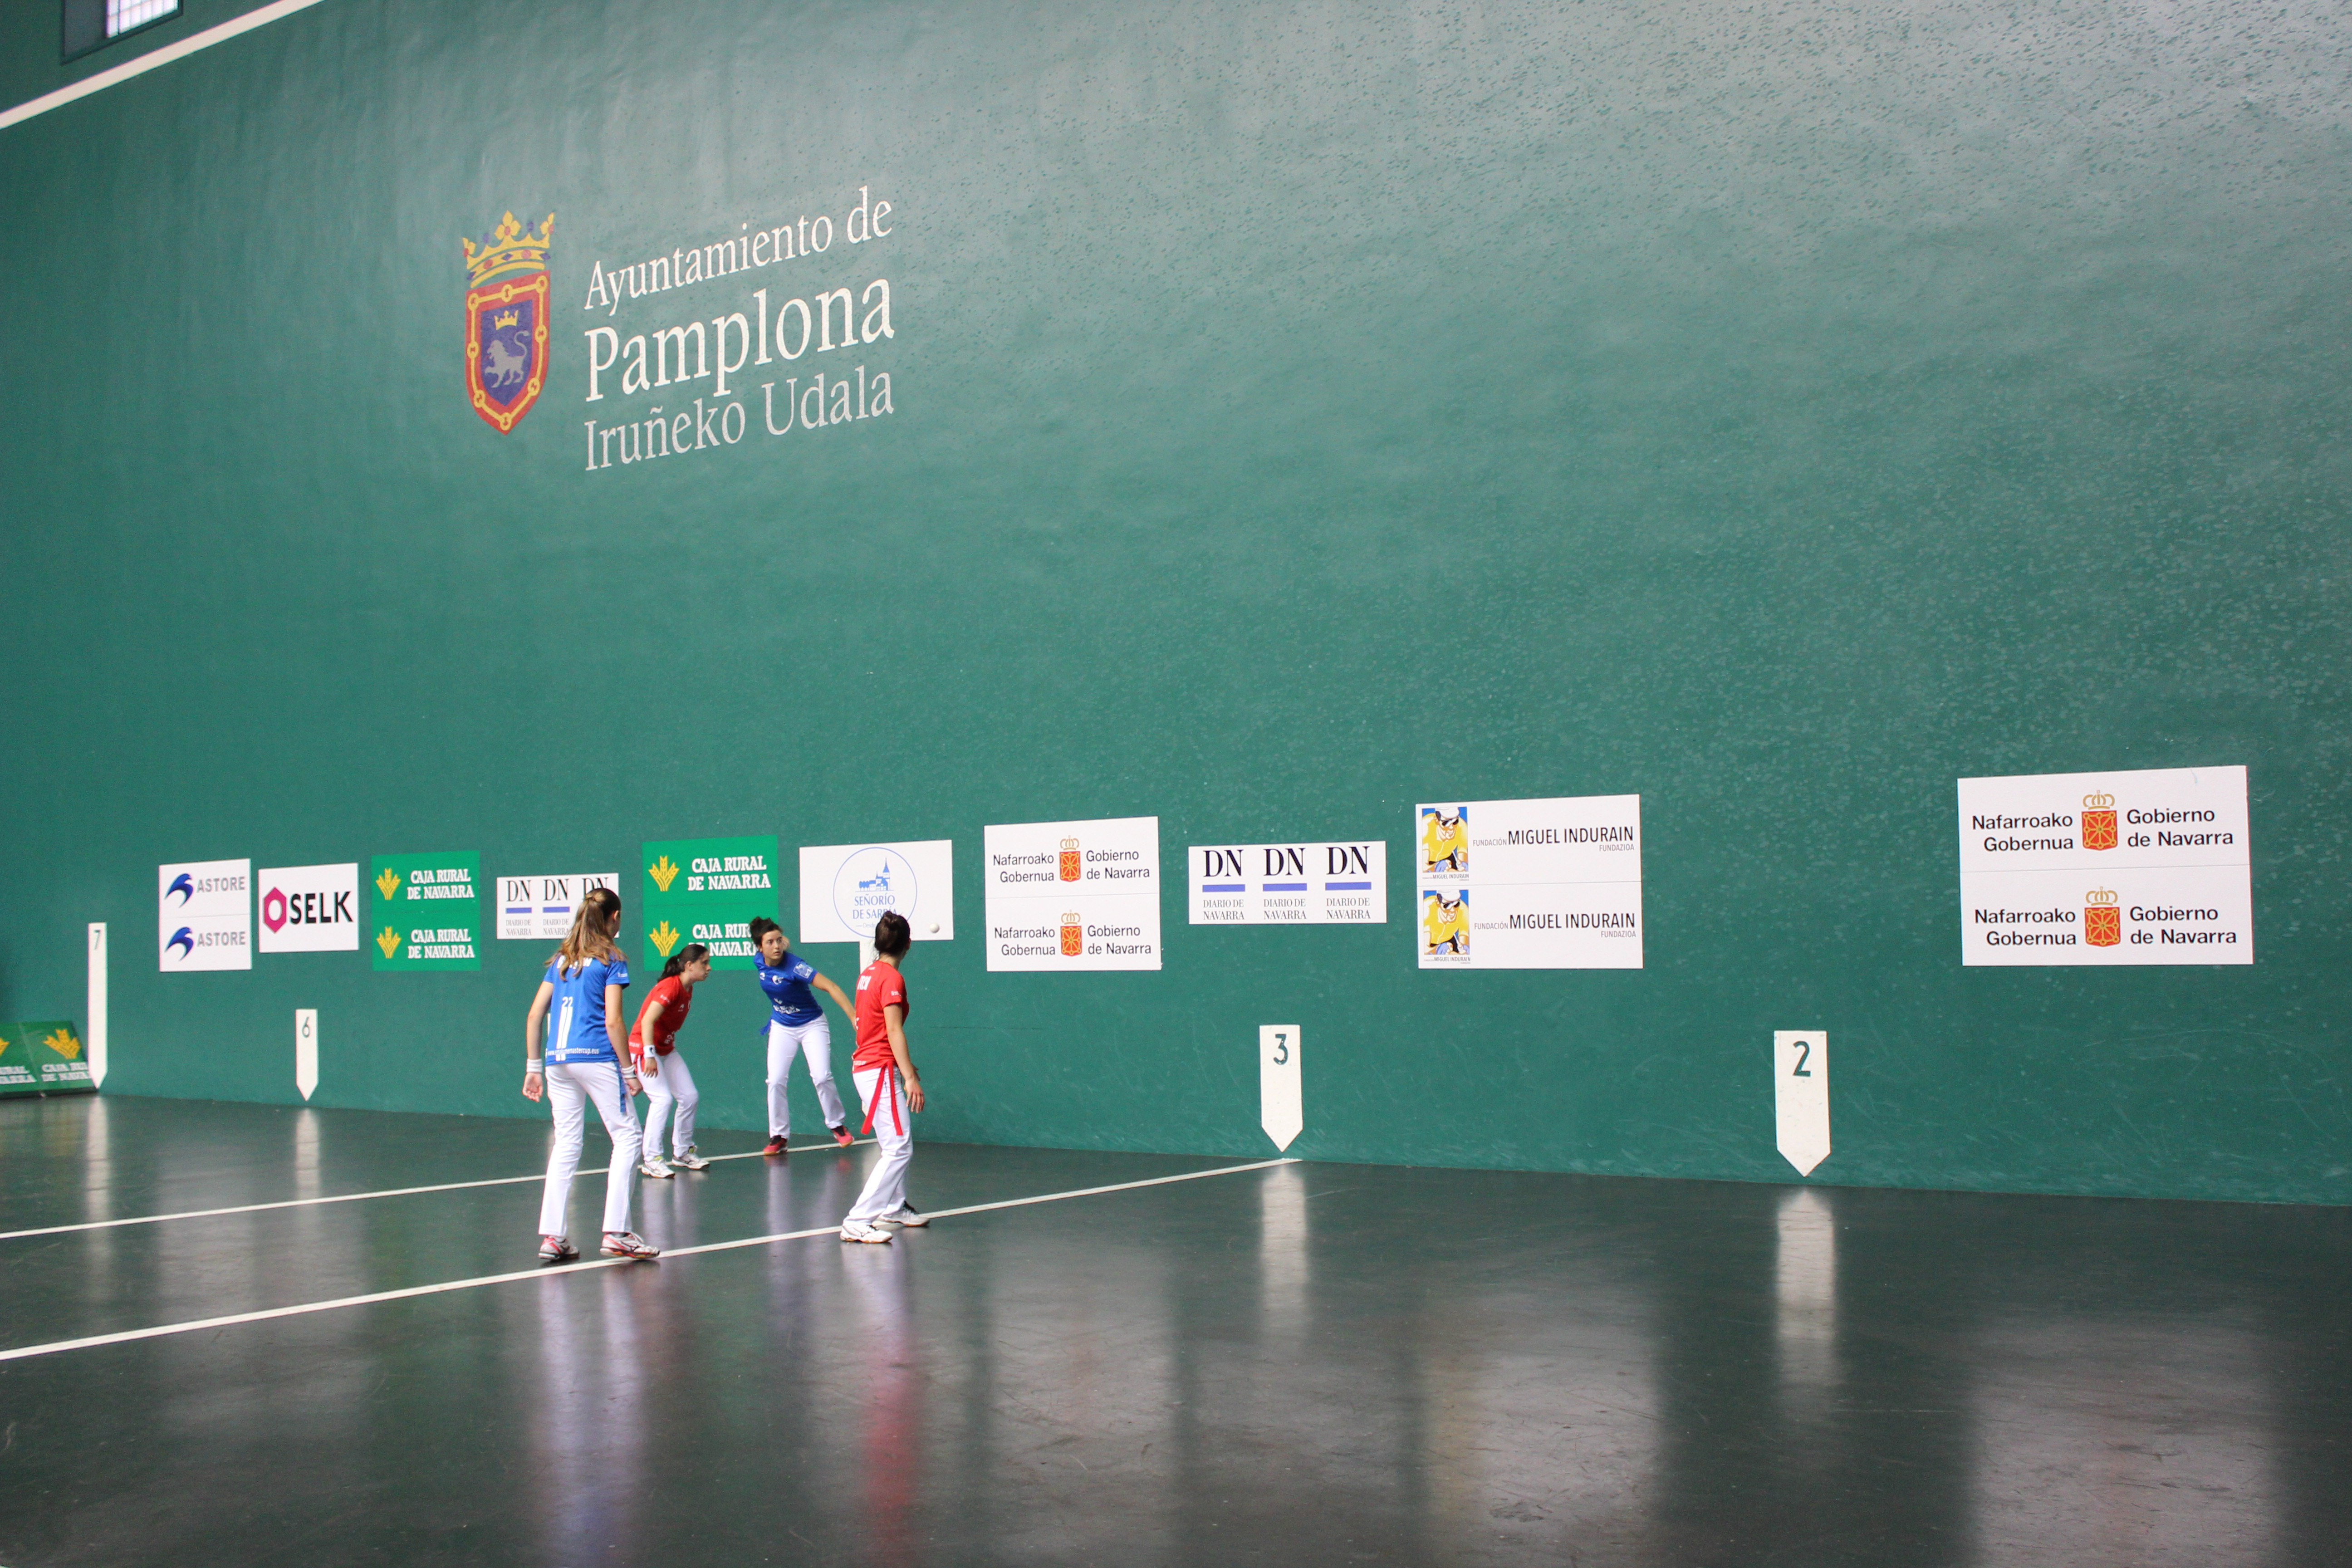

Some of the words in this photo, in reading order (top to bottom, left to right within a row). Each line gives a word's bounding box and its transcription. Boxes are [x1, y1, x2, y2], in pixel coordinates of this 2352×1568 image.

[584, 215, 833, 316] Ayuntamiento
[846, 185, 893, 244] de
[584, 277, 895, 402] Pamplona
[584, 397, 745, 471] Iruñeko
[761, 366, 894, 436] Udala
[1972, 812, 2073, 830] Nafarroako
[2127, 808, 2215, 824] Gobierno
[1473, 837, 1507, 847] FUNDACIÓN
[1508, 829, 1560, 845] MIGUEL
[1564, 826, 1634, 843] INDURAIN
[1984, 836, 2074, 852] Gobernua
[2127, 832, 2151, 847] de
[2158, 831, 2234, 847] Navarra
[1086, 849, 1139, 862] Gobierno
[1599, 844, 1635, 852] FUNDAZIOA
[691, 857, 721, 873] CAJA
[724, 855, 767, 872] RURAL
[993, 853, 1054, 866] Nafarroako
[1203, 849, 1244, 877] DN
[1264, 848, 1306, 876] DN
[1326, 846, 1370, 875] DN
[410, 870, 434, 884] CAJA
[436, 869, 471, 882] RURAL
[1000, 871, 1054, 883] Gobernua
[1086, 868, 1101, 880] de
[1104, 867, 1150, 879] Navarra
[196, 876, 245, 893] ASTORE
[544, 879, 569, 901] DN
[687, 875, 705, 891] DE
[708, 873, 771, 891] NAVARRA
[407, 886, 421, 900] DE
[423, 885, 475, 899] NAVARRA
[506, 880, 532, 902] DN
[854, 892, 896, 906] SEÑORÍO
[1203, 899, 1231, 908] DIARIO
[1233, 899, 1244, 908] DE
[1264, 899, 1293, 908] DIARIO
[1294, 898, 1306, 907] DE
[1326, 898, 1356, 907] DIARIO
[1357, 897, 1370, 906] DE
[853, 909, 864, 919] DE
[1203, 911, 1245, 921] NAVARRA
[1264, 910, 1307, 920] NAVARRA
[1326, 909, 1371, 919] NAVARRA
[1975, 907, 2076, 924] Nafarroako
[2130, 905, 2219, 921] Gobierno
[1474, 921, 1508, 930] FUNDACIÓN
[1509, 914, 1562, 929] MIGUEL
[1566, 913, 1635, 929] INDURAIN
[411, 929, 435, 943] CAJA
[436, 928, 471, 942] RURAL
[692, 924, 723, 940] CAJA
[995, 926, 1055, 939] Nafarroako
[1088, 924, 1141, 937] Gobierno
[1986, 931, 2077, 946] Gobernua
[2131, 930, 2154, 944] de
[2161, 929, 2237, 944] Navarra
[93, 929, 101, 950] 7
[197, 931, 246, 947] ASTORE
[407, 945, 421, 958] DE
[424, 945, 475, 959] NAVARRA
[1001, 944, 1056, 956] Gobernua
[1088, 943, 1102, 954] de
[1106, 942, 1152, 954] Navarra
[562, 996, 573, 1008] 22
[301, 1016, 310, 1039] 6
[1273, 1034, 1289, 1065] 3
[1793, 1041, 1812, 1077] 2
